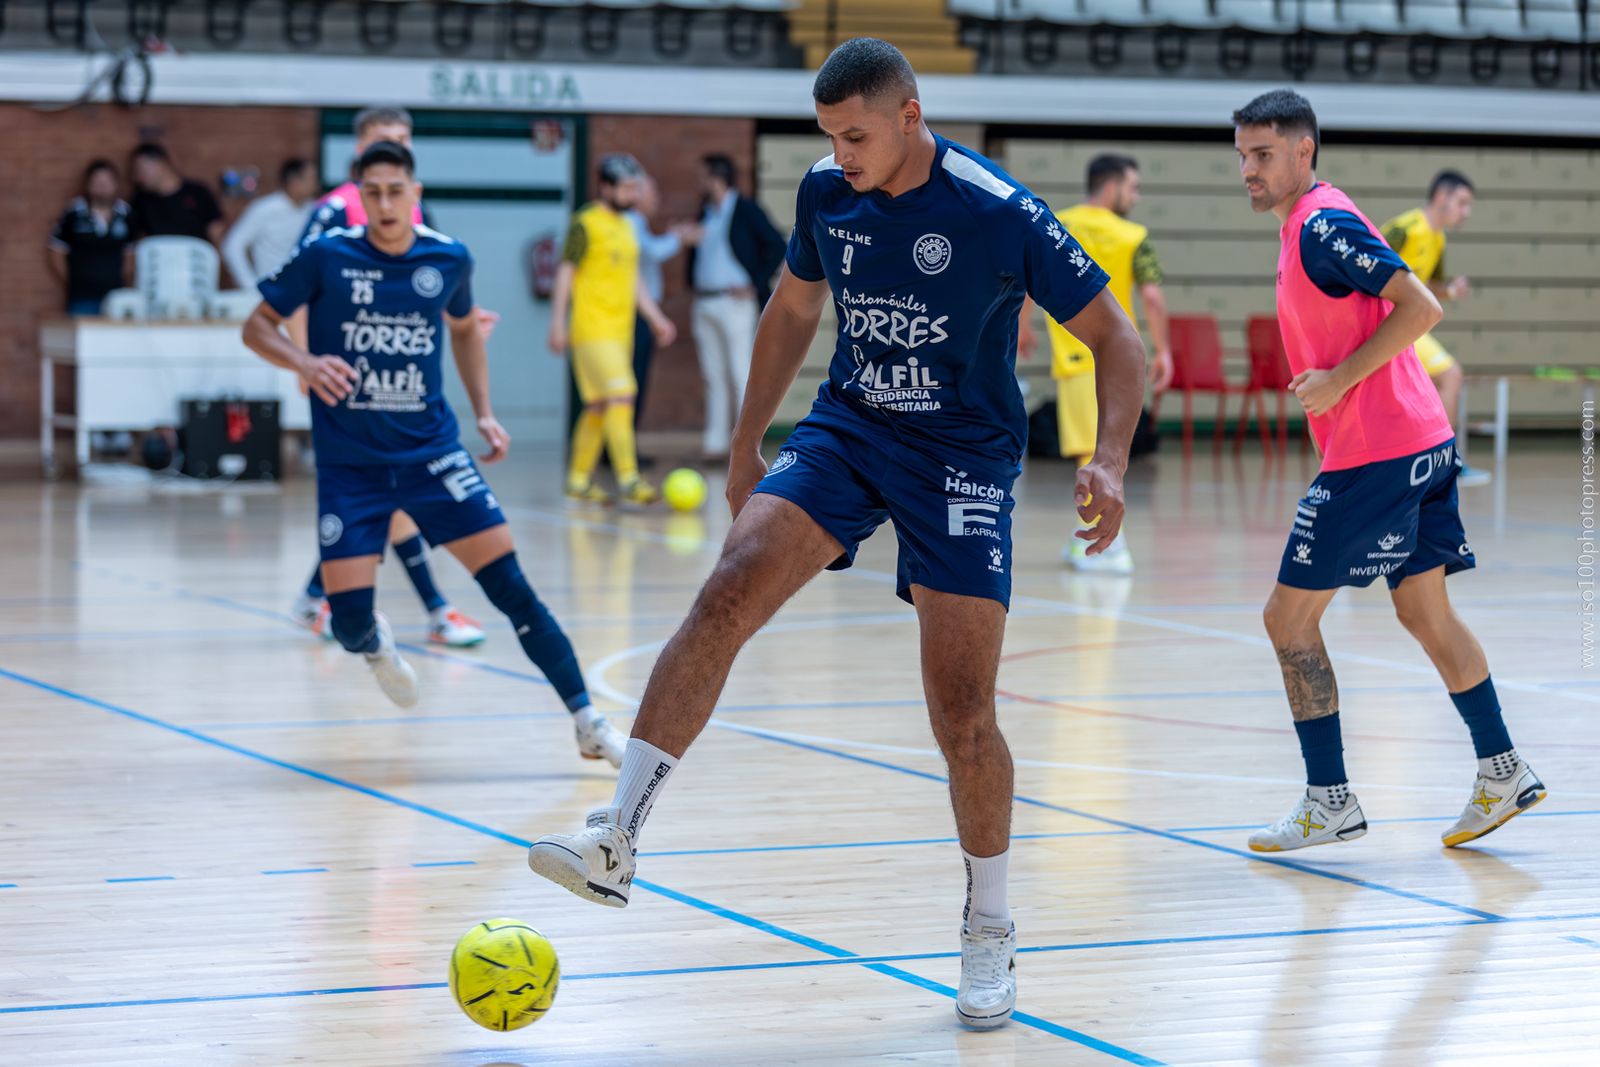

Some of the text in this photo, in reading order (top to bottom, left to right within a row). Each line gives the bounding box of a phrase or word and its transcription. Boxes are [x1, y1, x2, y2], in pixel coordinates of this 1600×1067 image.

[429, 67, 581, 104] SALIDA
[828, 226, 872, 246] KELME
[1054, 233, 1069, 250] KELME
[841, 244, 854, 276] 9
[1076, 258, 1093, 278] KELME
[351, 279, 375, 305] 25
[842, 287, 928, 314] Automóviles
[341, 321, 437, 356] TORRES
[859, 398, 941, 412] RSITARIA
[865, 389, 931, 403] RESIDENCIA
[945, 476, 1004, 502] Halcón
